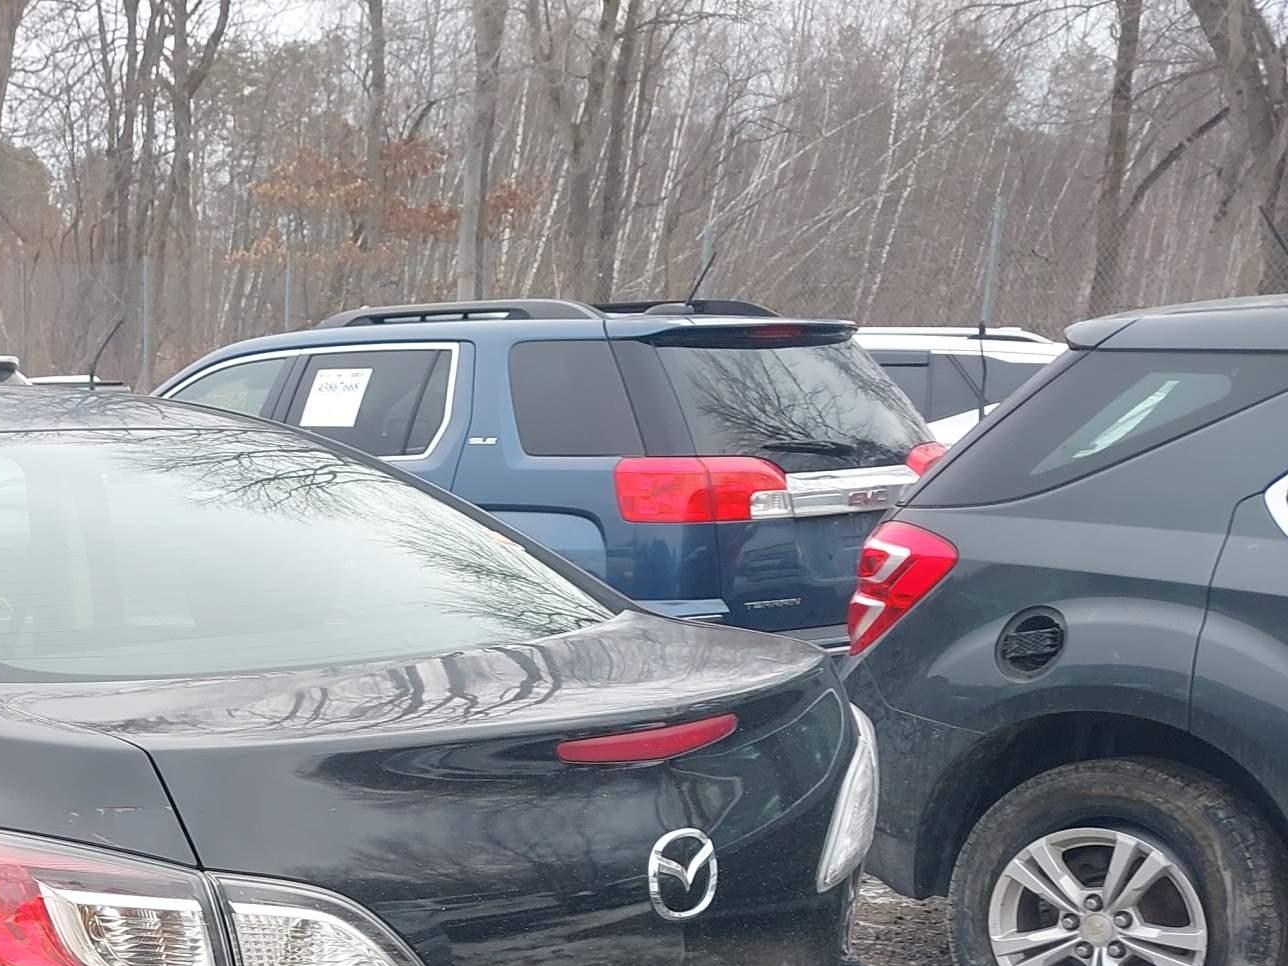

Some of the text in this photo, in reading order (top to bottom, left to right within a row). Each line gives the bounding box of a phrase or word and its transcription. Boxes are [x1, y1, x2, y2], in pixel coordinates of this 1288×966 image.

[468, 437, 498, 445] SLE
[848, 488, 888, 507] GMC
[744, 597, 802, 610] TERRAIN
